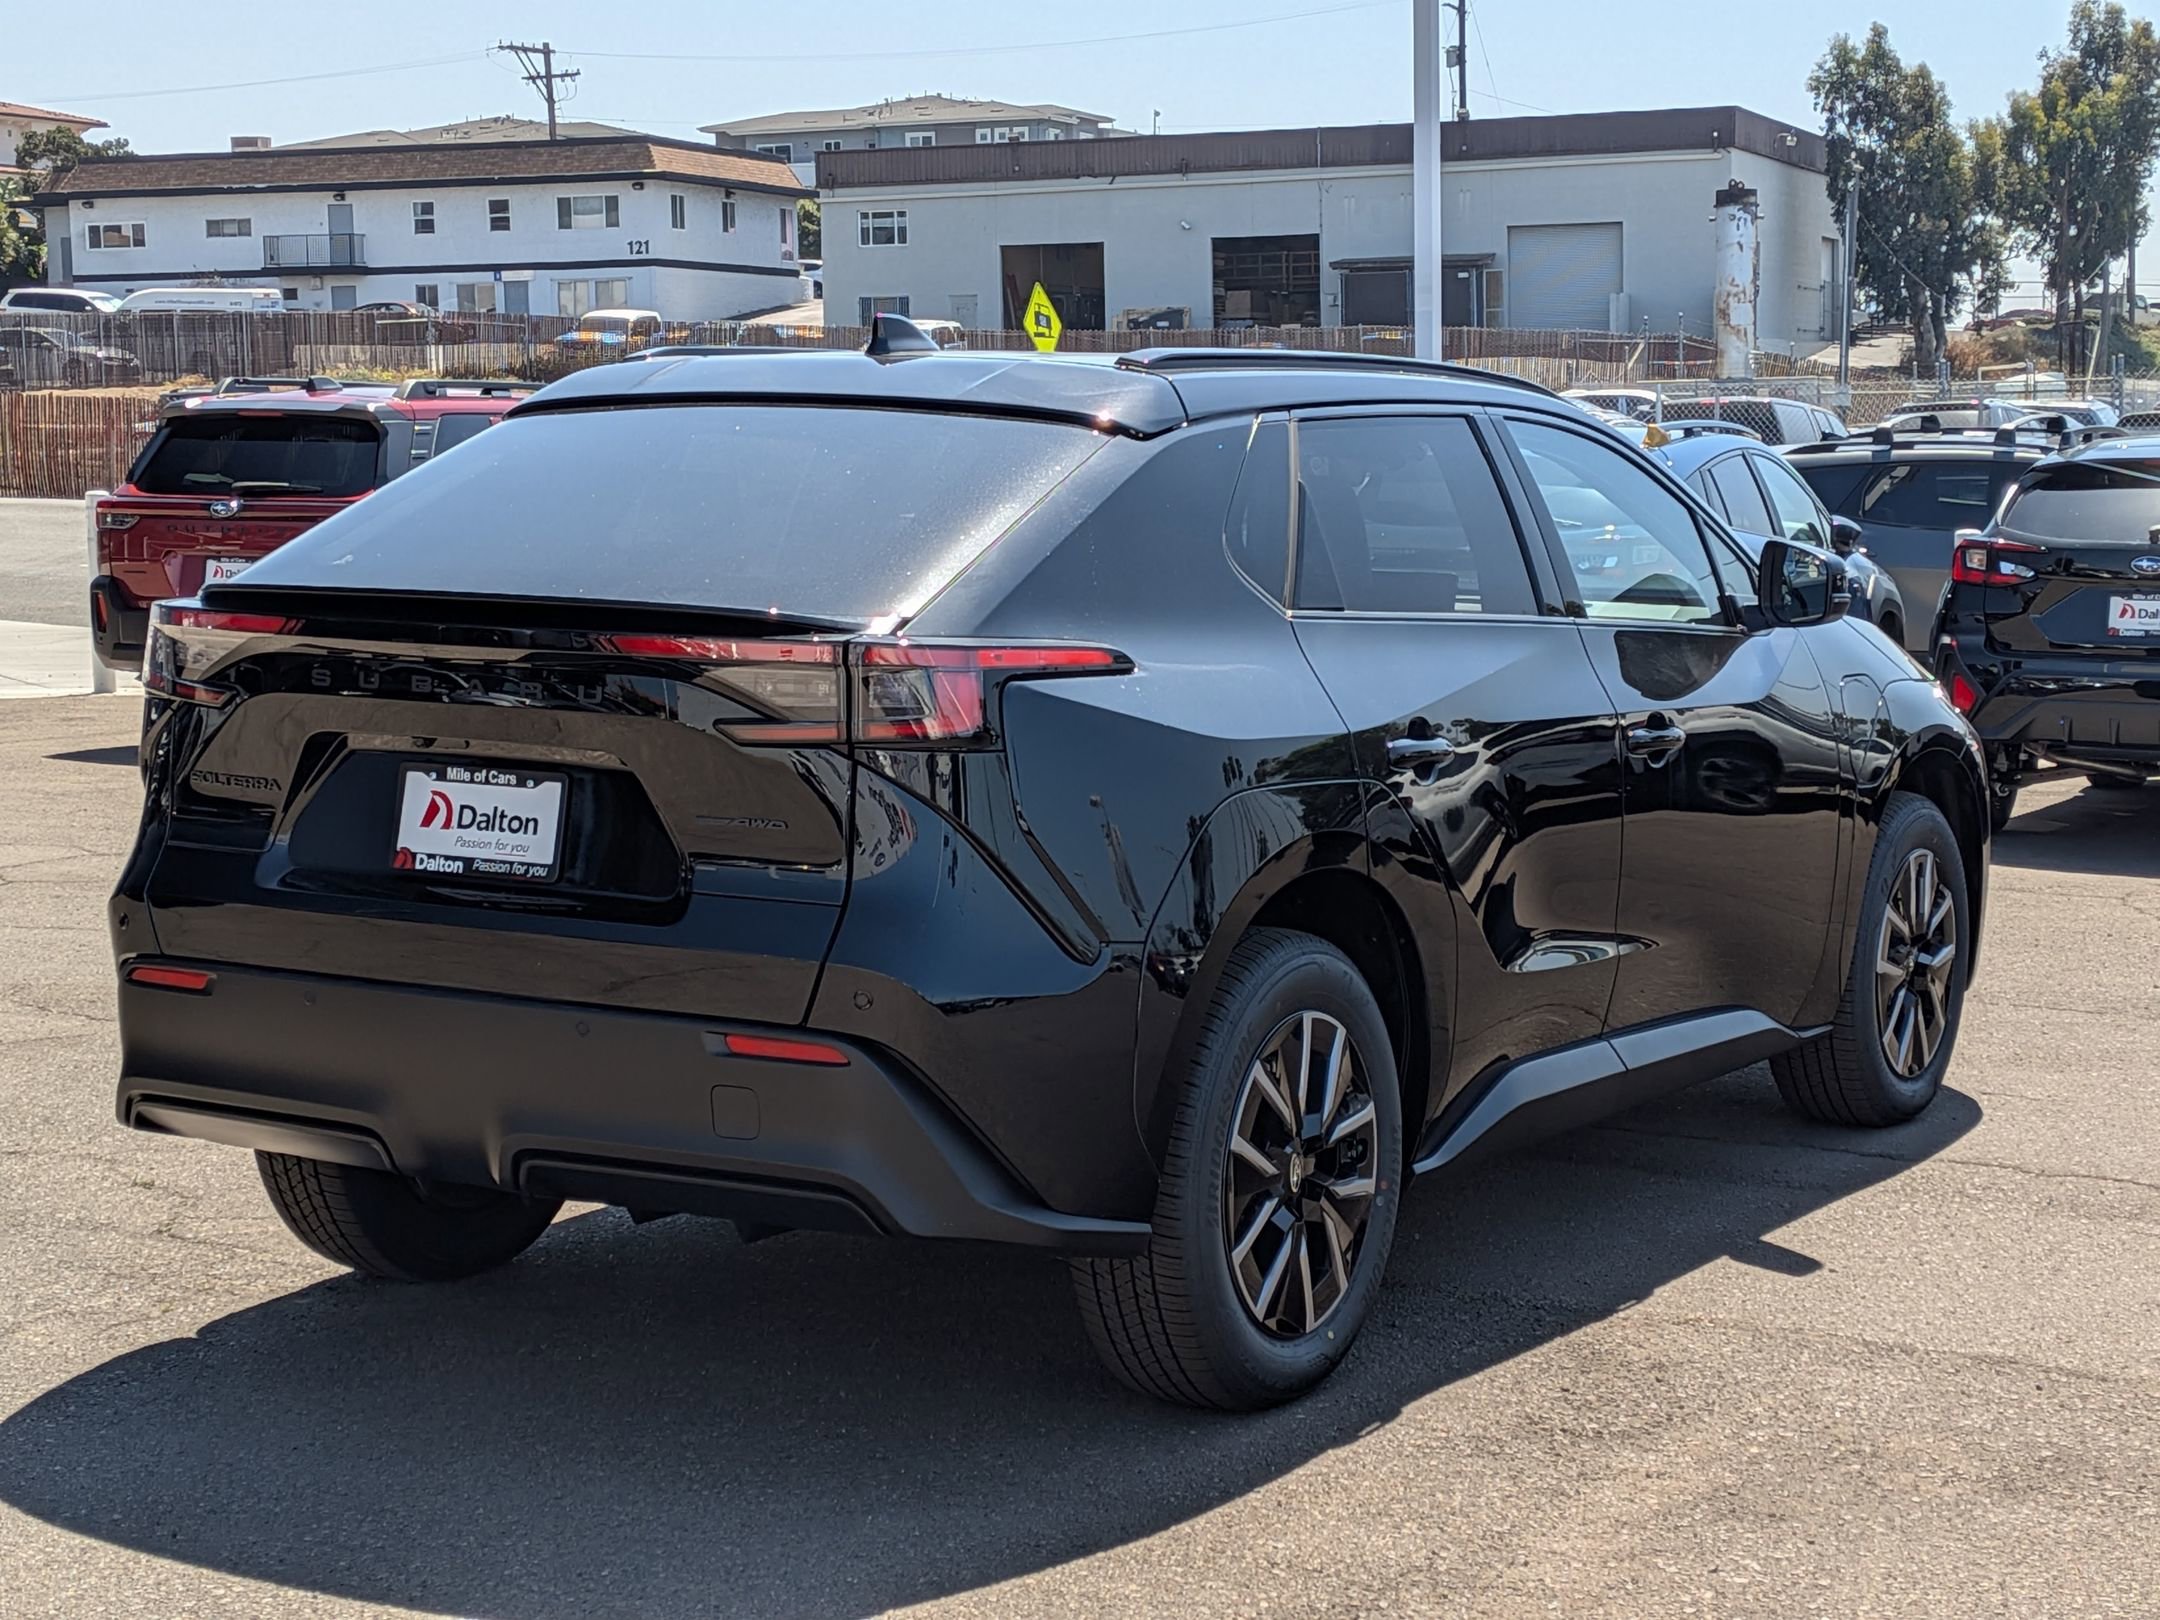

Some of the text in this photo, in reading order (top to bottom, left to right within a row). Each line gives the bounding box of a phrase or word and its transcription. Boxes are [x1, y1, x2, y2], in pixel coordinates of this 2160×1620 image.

[627, 240, 650, 255] 121
[311, 667, 604, 705] SUBARU
[191, 769, 282, 792] SOLTERRA
[446, 766, 517, 785] Mile of Cars
[456, 803, 539, 836] Dalton
[454, 835, 530, 854] Passion for you
[414, 853, 549, 878] Dalton Passion for you
